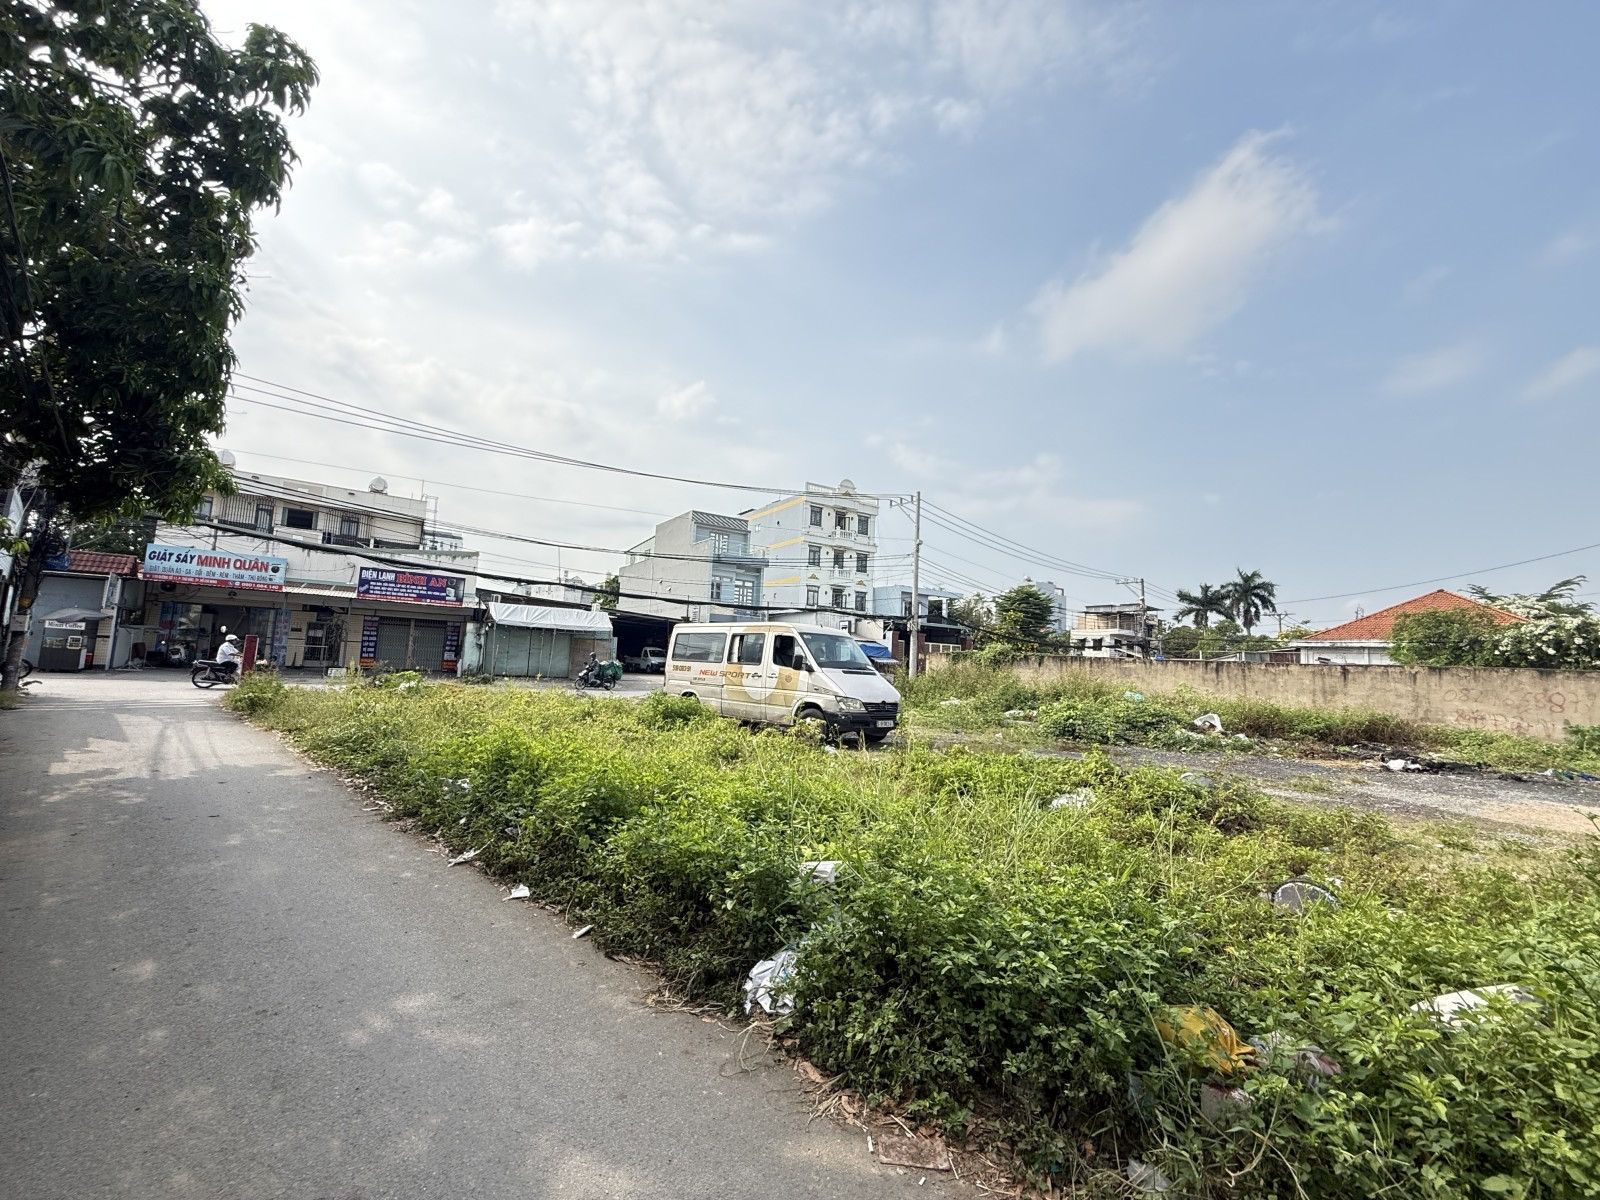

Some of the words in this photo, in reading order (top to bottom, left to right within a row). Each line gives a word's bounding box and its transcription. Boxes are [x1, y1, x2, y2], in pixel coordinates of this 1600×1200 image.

[148, 550, 173, 565] GIẶT
[175, 549, 197, 565] SẤY
[196, 554, 231, 570] MINH
[233, 557, 270, 573] QUÂN
[361, 569, 378, 580] ĐIỆN
[378, 570, 395, 582] LẠNH
[396, 573, 427, 584] BÌNH
[429, 577, 447, 588] AN
[698, 669, 718, 677] NEW
[719, 671, 751, 679] SPORT
